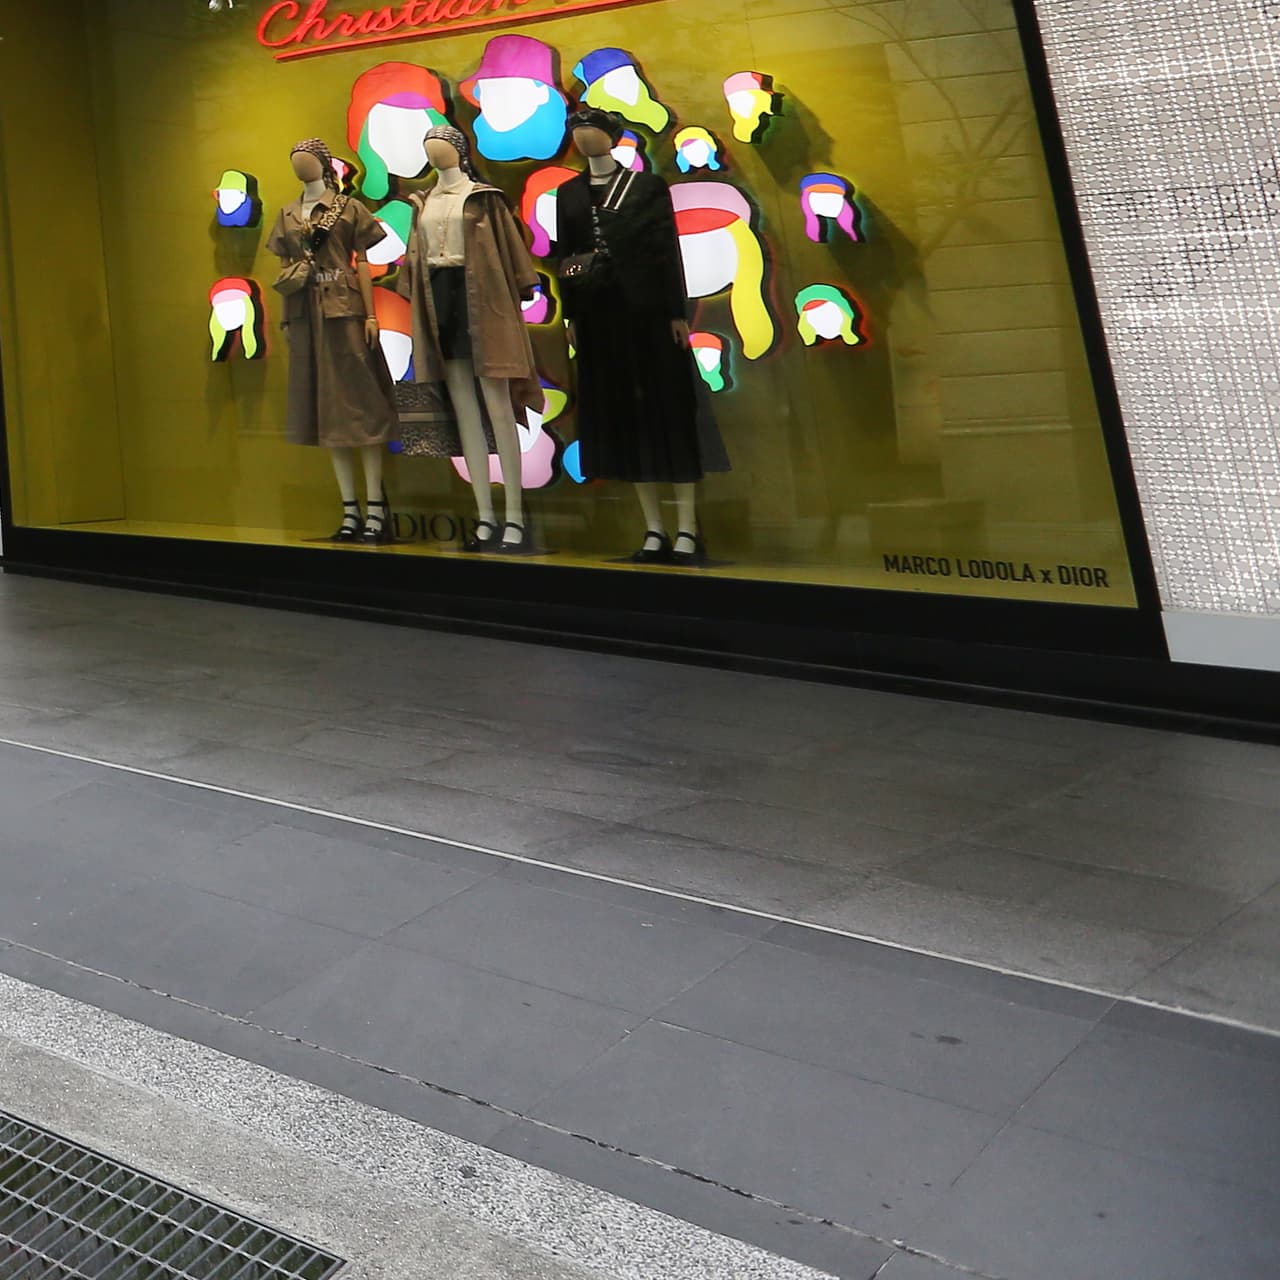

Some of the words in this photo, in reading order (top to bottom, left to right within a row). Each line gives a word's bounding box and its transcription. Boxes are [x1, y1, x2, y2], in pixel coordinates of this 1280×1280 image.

[883, 554, 951, 577] MARCO
[956, 558, 1036, 583] LODOLA
[1039, 569, 1054, 585] x
[1057, 565, 1110, 589] DIOR
